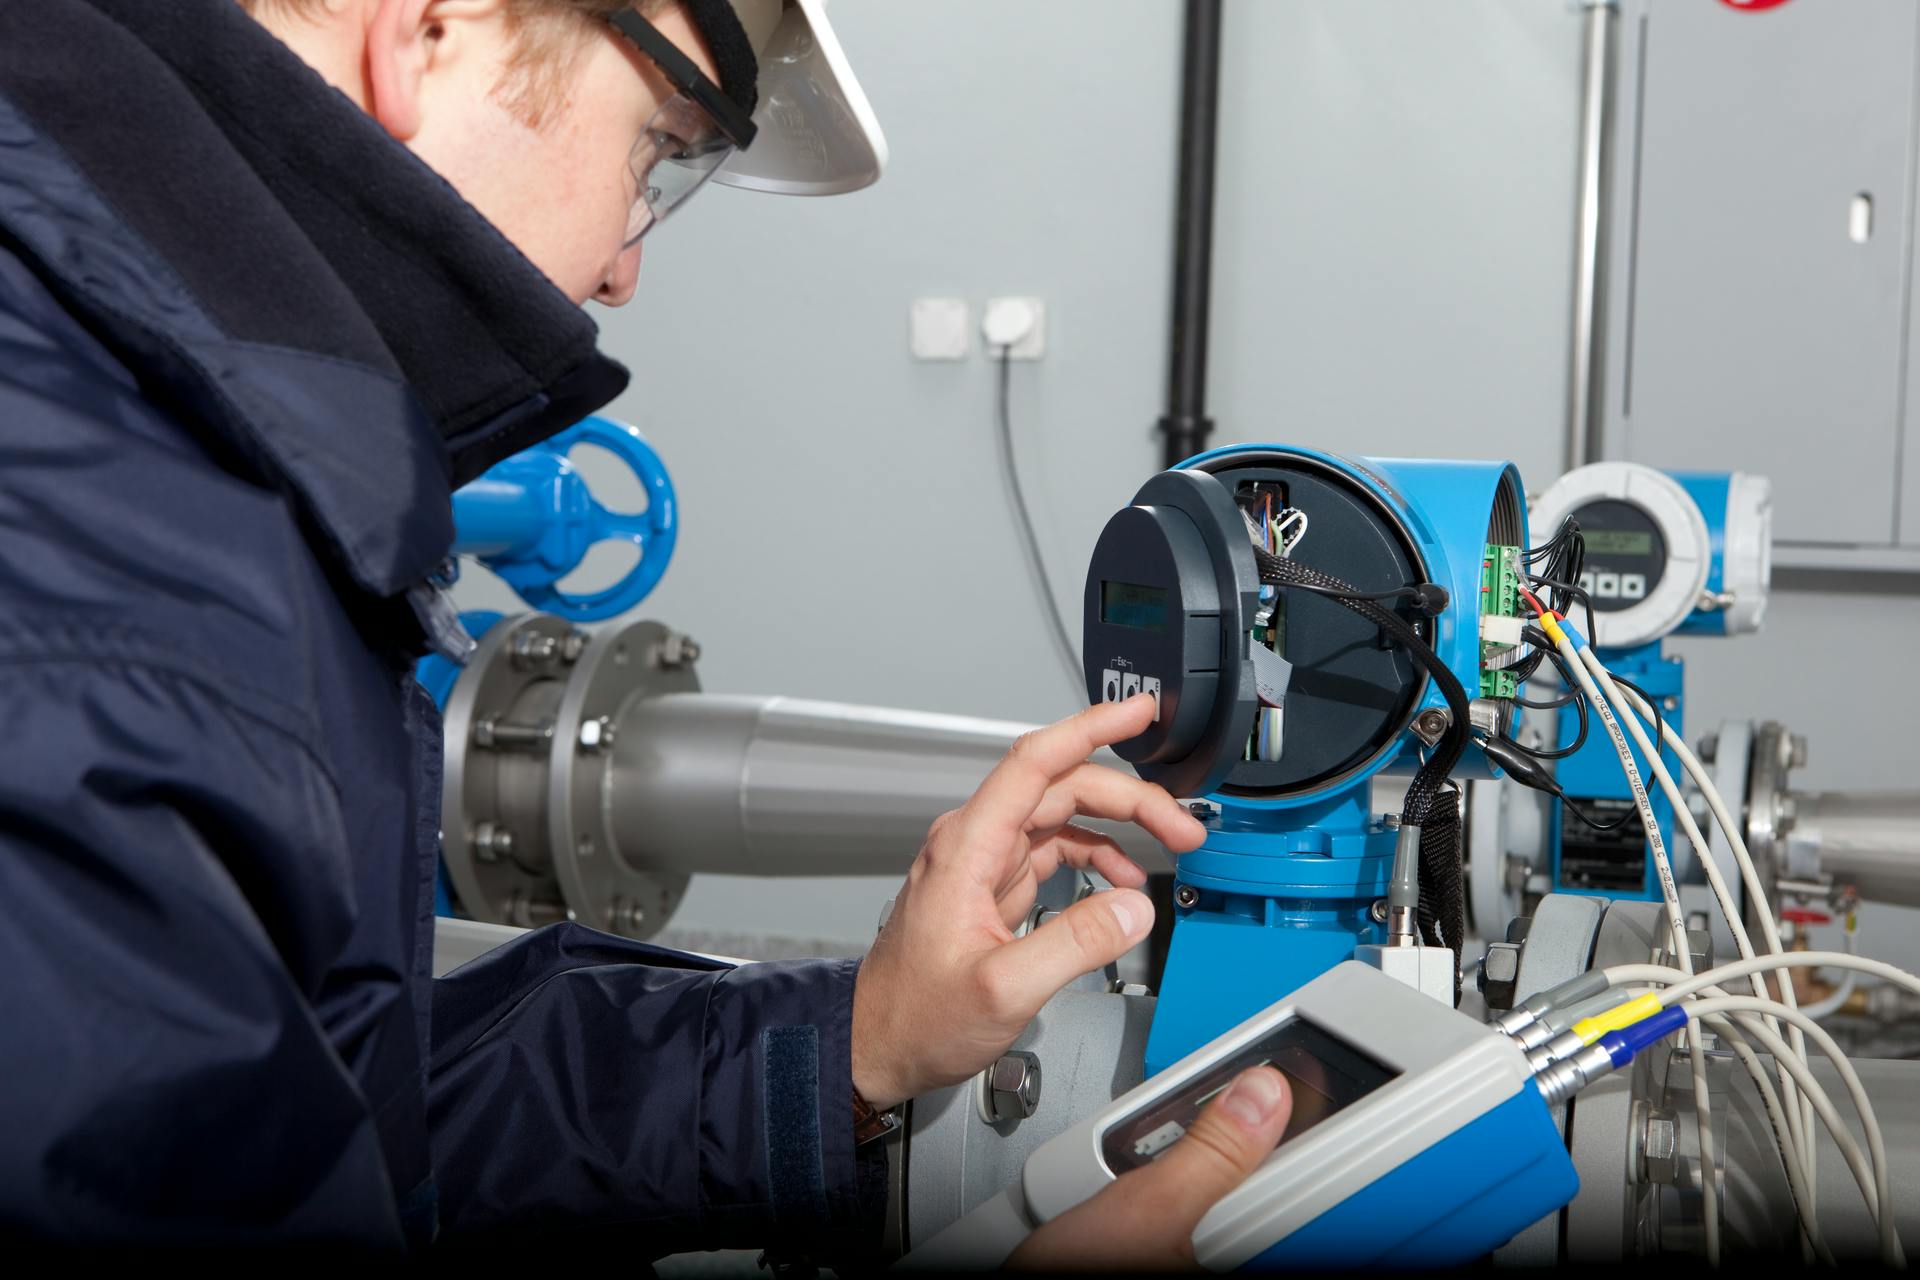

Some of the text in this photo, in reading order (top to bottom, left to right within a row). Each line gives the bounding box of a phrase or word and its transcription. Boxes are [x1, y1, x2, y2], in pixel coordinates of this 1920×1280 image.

[1117, 656, 1127, 667] Esc
[1595, 694, 1613, 721] SAB
[1611, 723, 1632, 760] BROCKSKES
[1629, 769, 1650, 811] D-VIERSEN
[1651, 834, 1662, 849] 200
